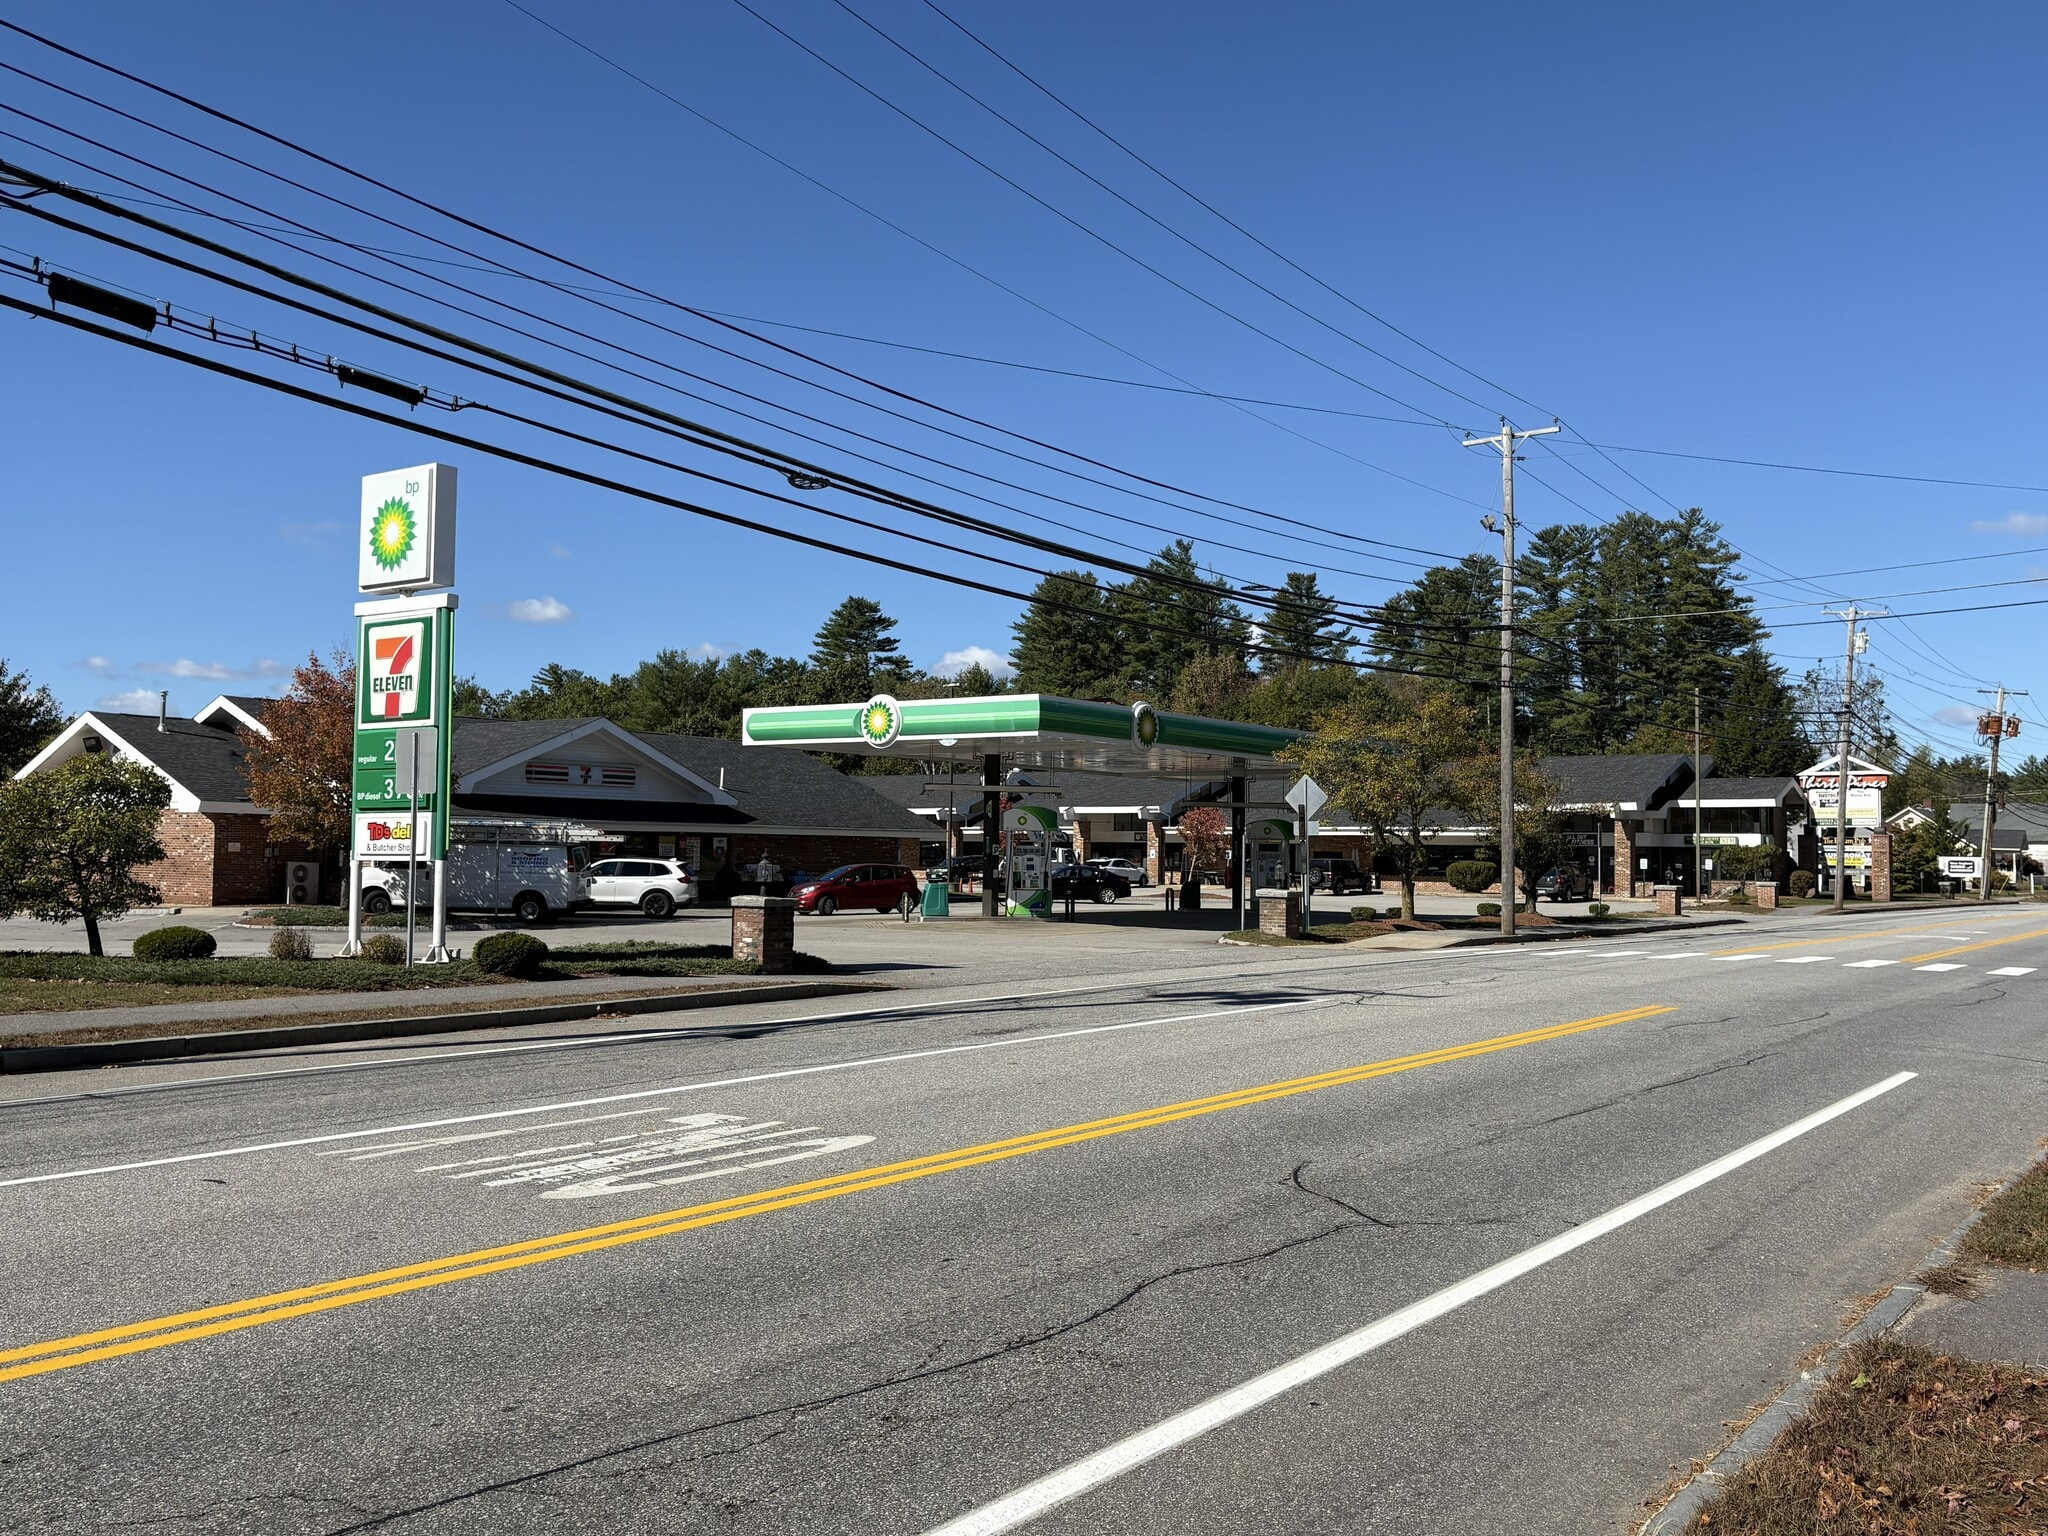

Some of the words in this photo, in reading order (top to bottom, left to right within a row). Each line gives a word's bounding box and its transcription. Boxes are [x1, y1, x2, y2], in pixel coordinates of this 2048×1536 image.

[405, 480, 420, 496] bp
[358, 755, 377, 765] regular
[1799, 776, 1840, 790] Thirt
[1847, 775, 1888, 790] Pines
[365, 792, 381, 800] diesel
[368, 822, 391, 841] TD's
[392, 822, 412, 840] del
[398, 843, 411, 851] Sho
